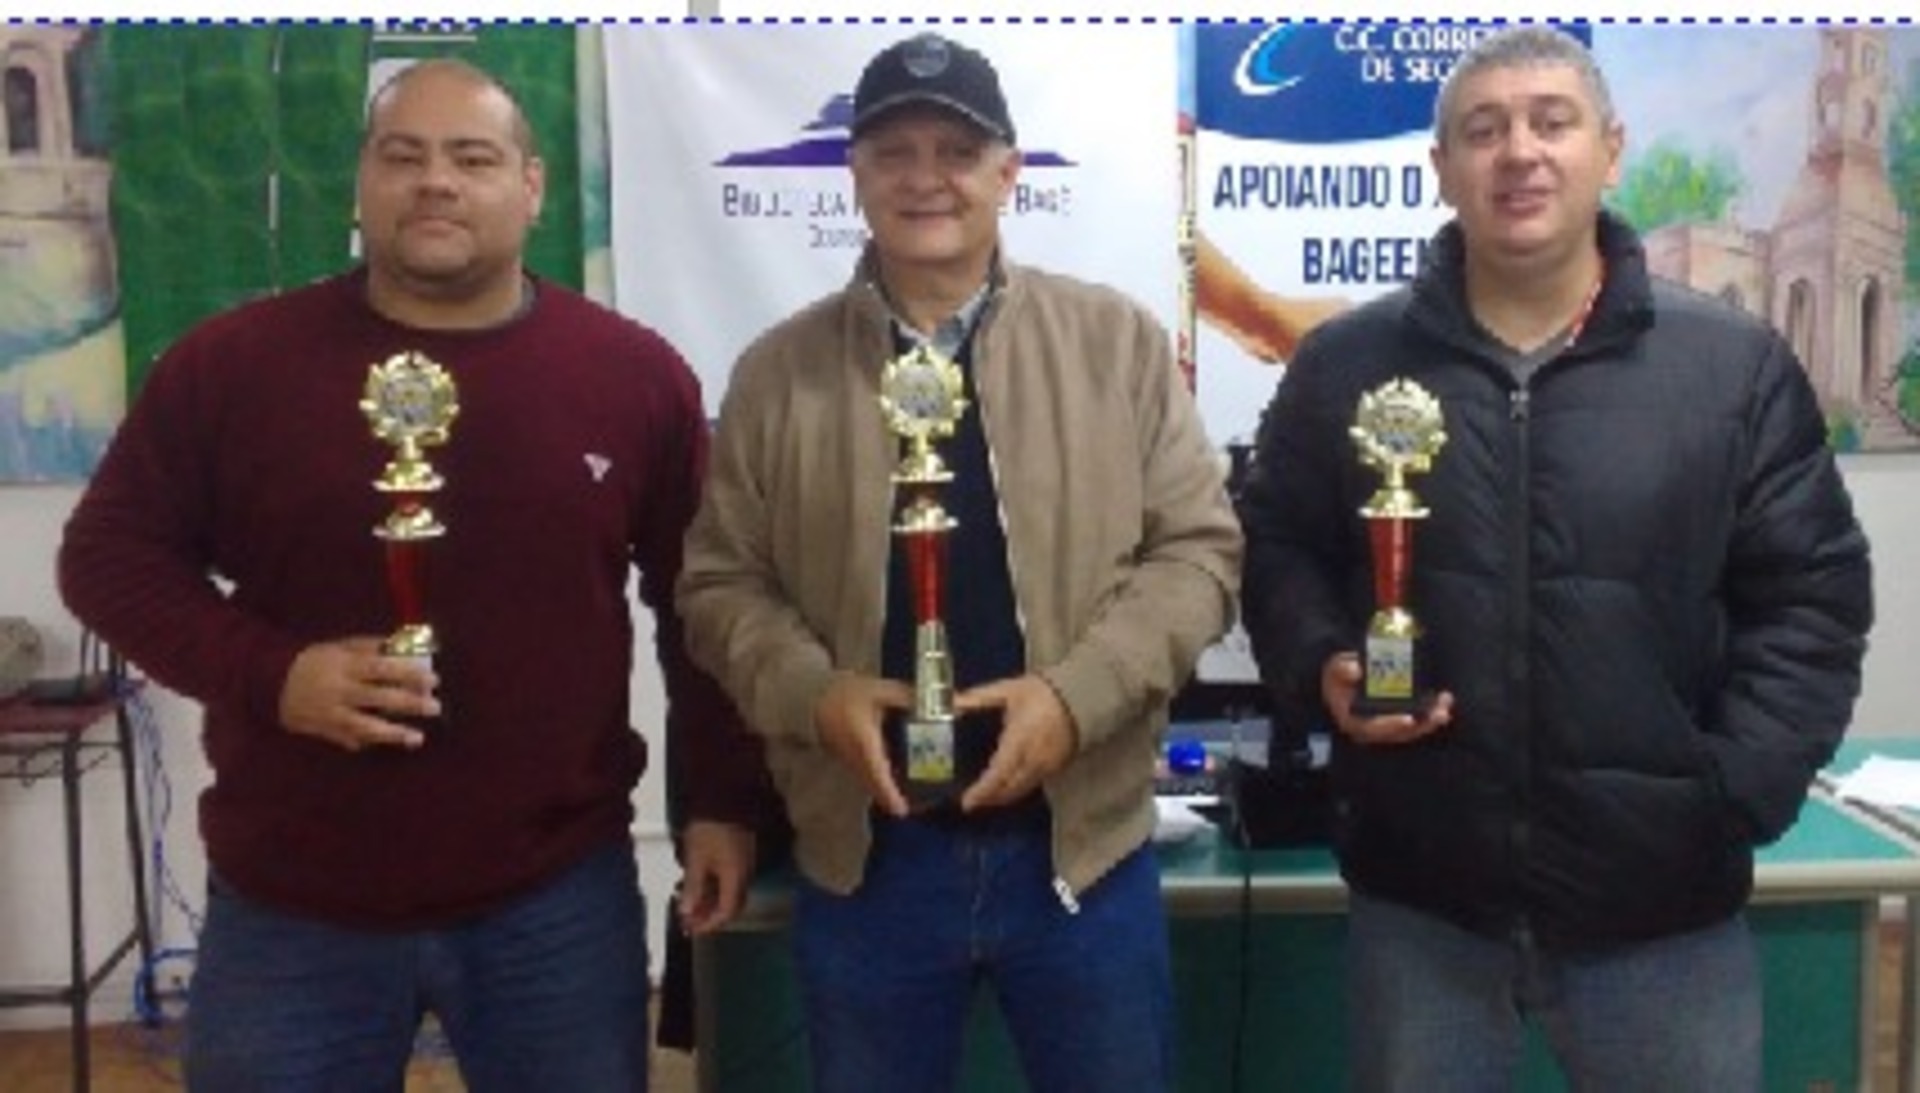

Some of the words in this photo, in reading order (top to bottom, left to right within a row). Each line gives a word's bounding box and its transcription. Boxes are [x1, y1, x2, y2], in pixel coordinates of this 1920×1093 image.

[1361, 57, 1395, 82] DE
[1213, 165, 1391, 208] APOIANDO
[1402, 165, 1422, 208] O
